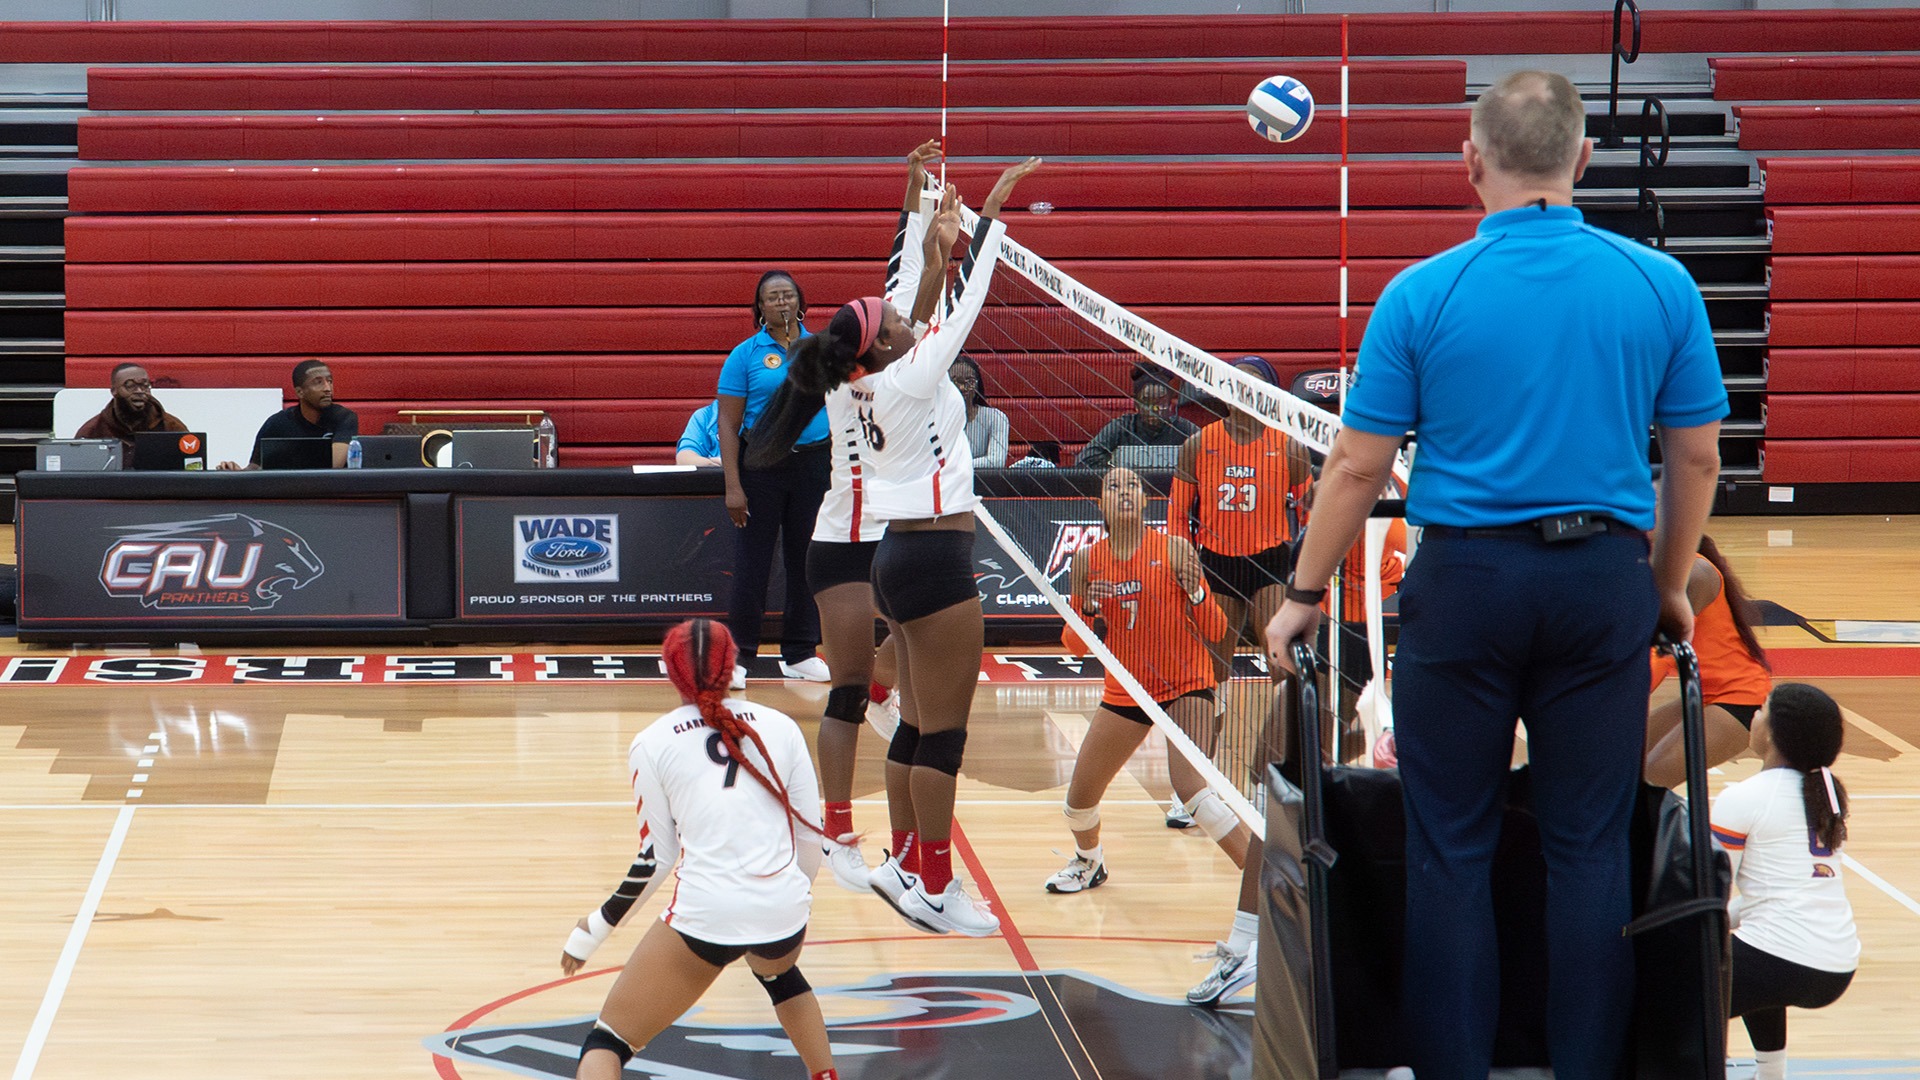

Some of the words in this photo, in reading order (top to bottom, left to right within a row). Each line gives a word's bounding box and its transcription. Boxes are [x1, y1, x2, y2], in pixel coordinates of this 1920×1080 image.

[1217, 483, 1257, 512] 23
[519, 518, 612, 543] WADE
[545, 541, 588, 558] Ford
[522, 559, 561, 577] SMYRNA
[575, 559, 612, 578] VININGS
[160, 592, 250, 604] PANTHERS
[470, 596, 515, 604] PROUD
[520, 595, 584, 604] SPONSOR
[588, 594, 606, 603] OF
[611, 594, 636, 603] THE
[640, 593, 713, 603] PANTHERS
[1120, 599, 1138, 630] 7
[704, 732, 740, 789] 9
